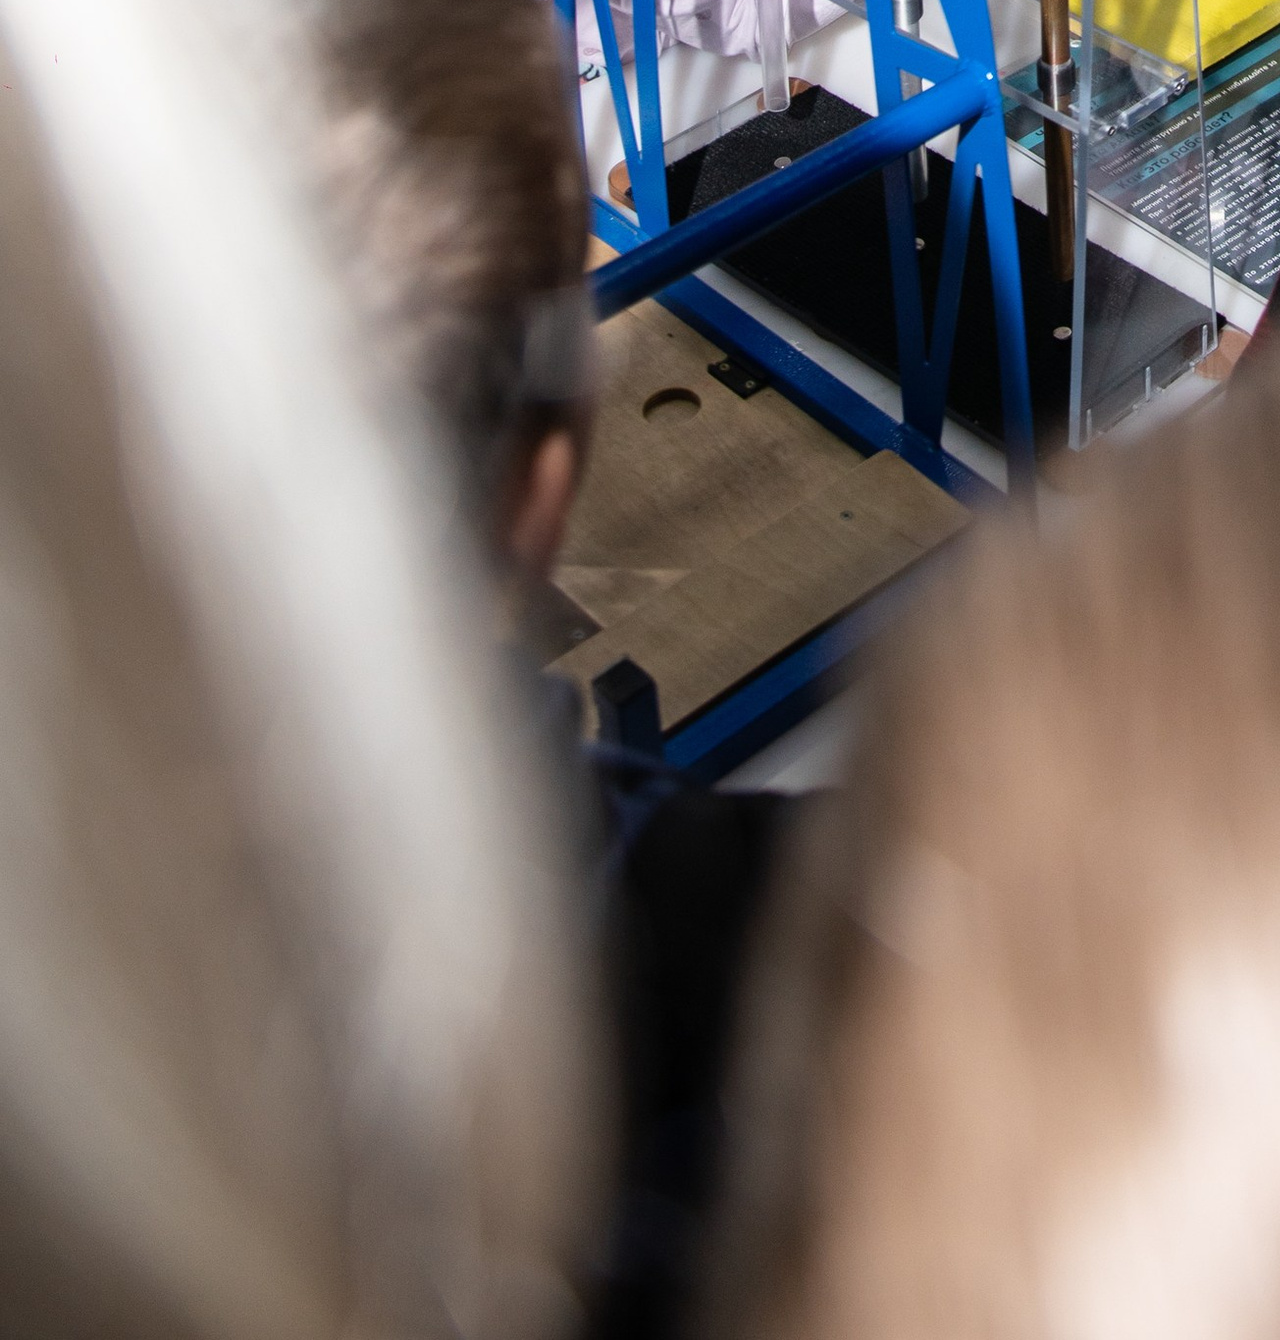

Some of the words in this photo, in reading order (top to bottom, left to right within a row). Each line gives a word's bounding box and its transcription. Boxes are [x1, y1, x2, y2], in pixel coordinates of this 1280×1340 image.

[1137, 116, 1189, 150] конструкцию
[1224, 63, 1270, 93] наблюдайте
[1114, 169, 1146, 190] Как
[1142, 154, 1172, 174] это
[1167, 109, 1235, 161] рабоает?
[1128, 182, 1169, 209] Магнитный
[1224, 122, 1260, 145] маятника,
[1138, 196, 1166, 214] магнит
[1217, 135, 1256, 160] состоящей
[1163, 185, 1200, 209] движении
[1227, 149, 1249, 164] мимо
[1165, 207, 1200, 231] маятника
[1222, 175, 1243, 189] из-за
